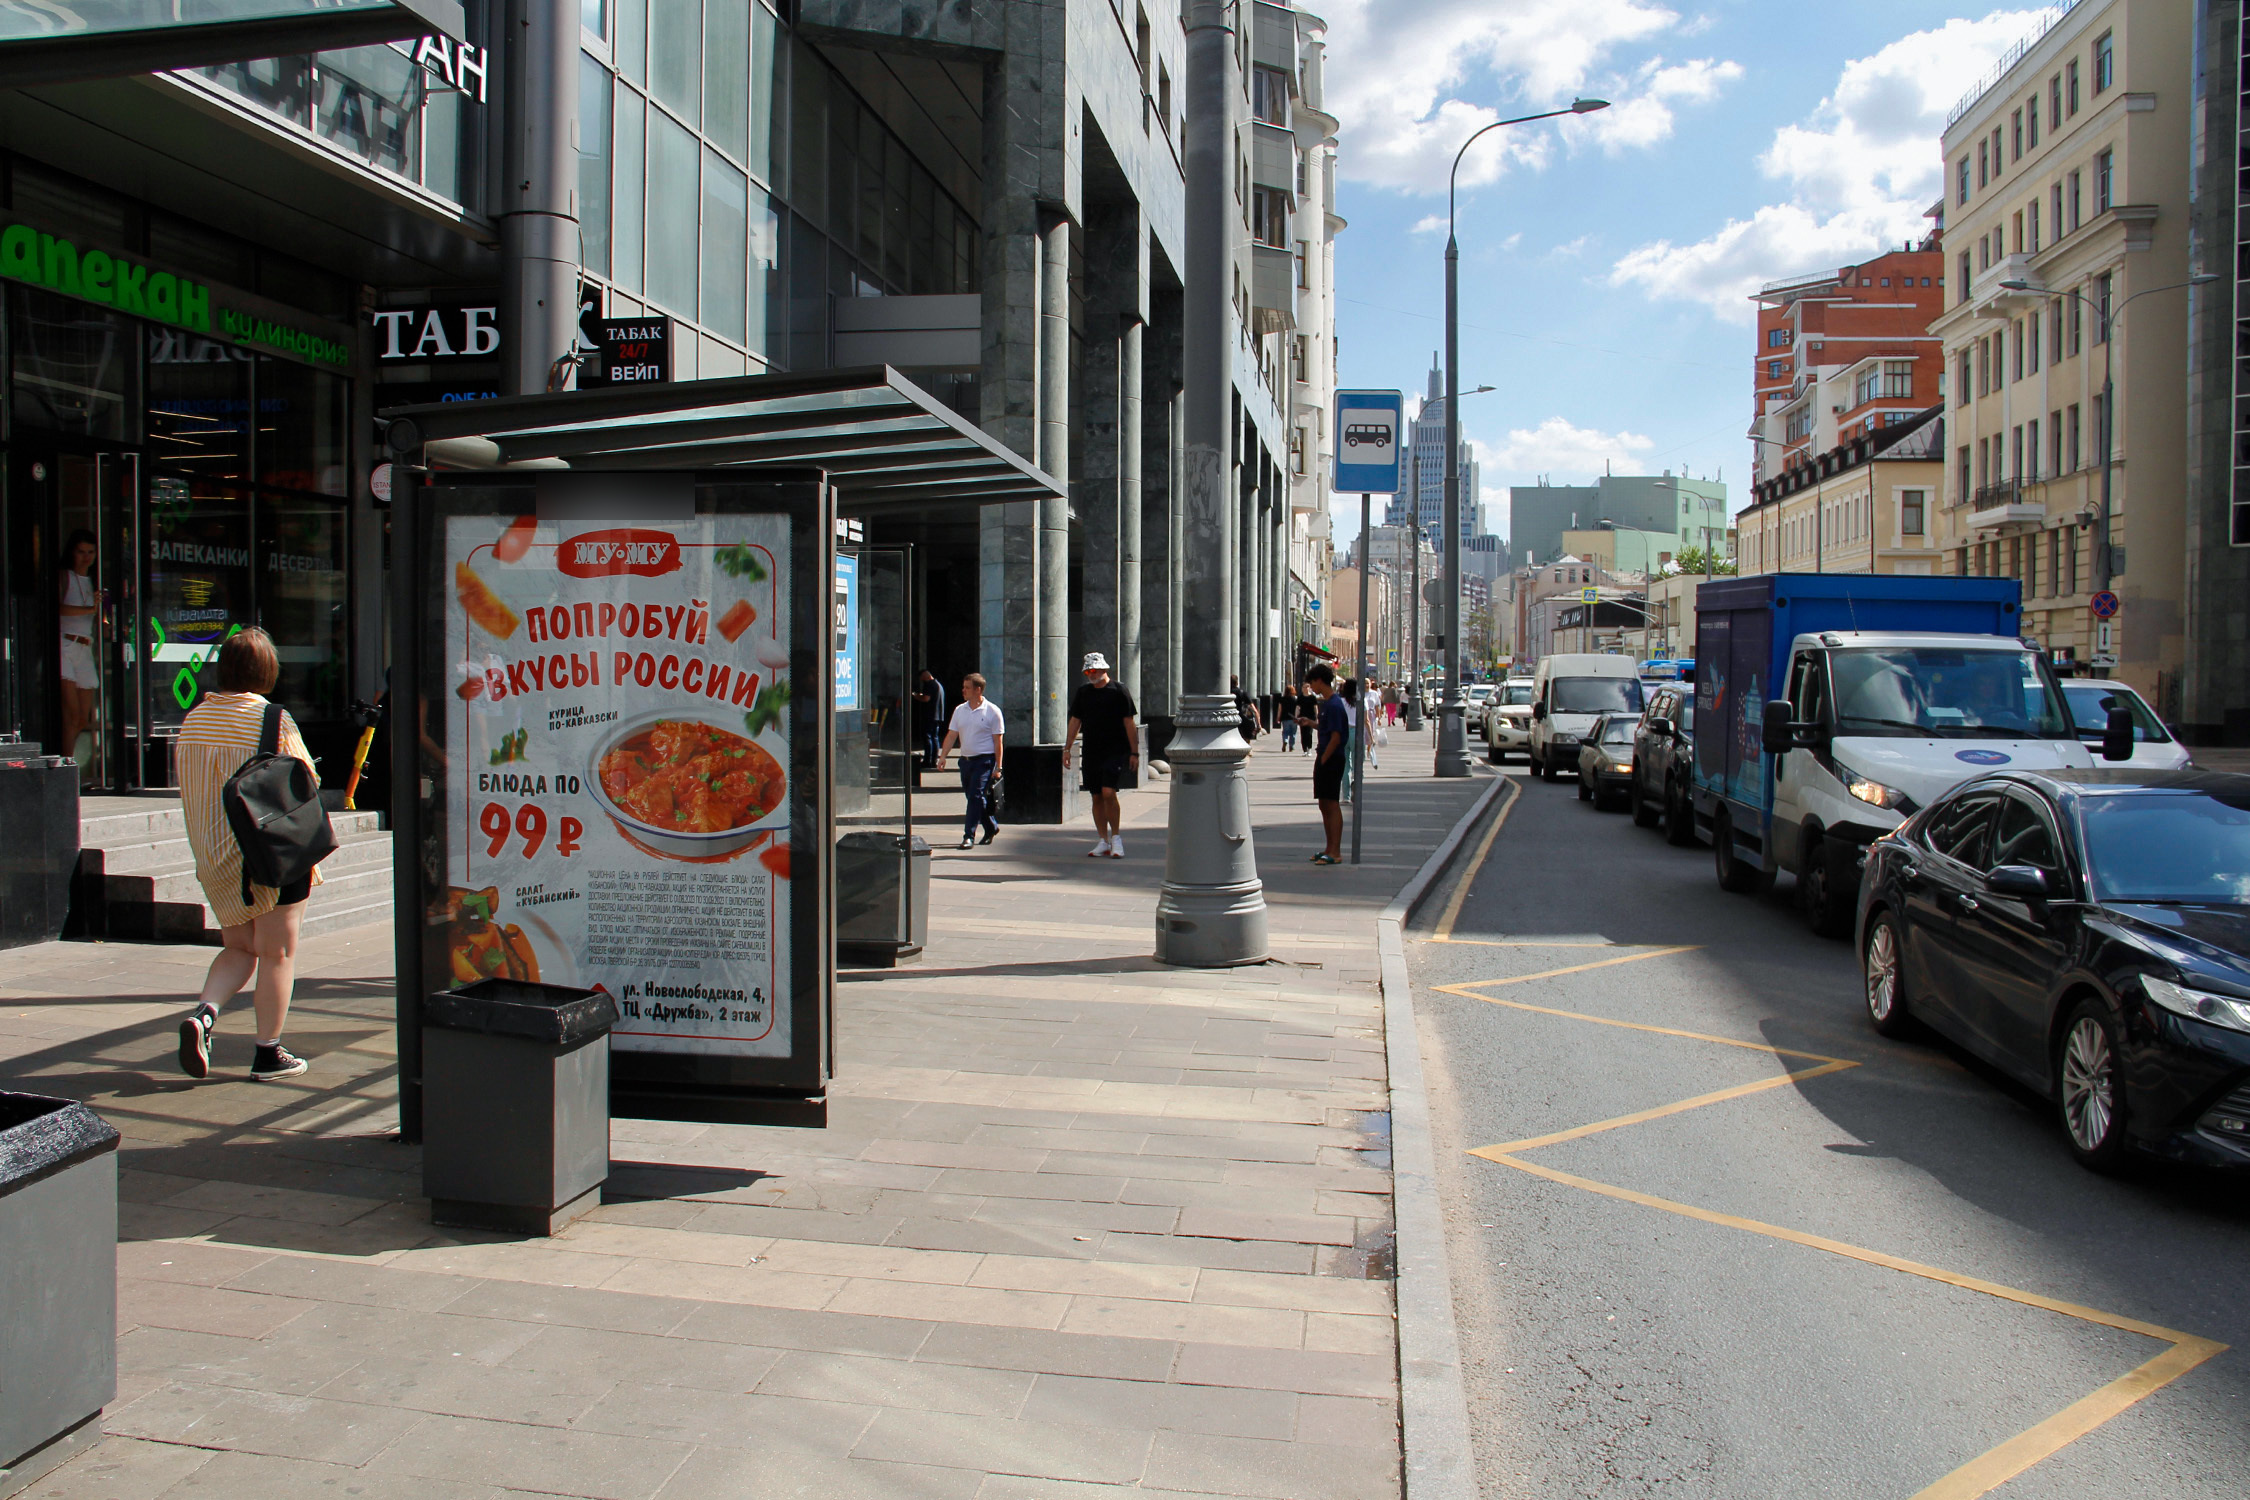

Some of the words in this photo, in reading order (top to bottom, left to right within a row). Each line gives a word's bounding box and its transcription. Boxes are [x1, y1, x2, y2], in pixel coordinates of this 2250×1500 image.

[219, 307, 348, 367] кулинария
[606, 326, 662, 341] ТАБАК
[619, 343, 649, 359] 24/7
[611, 362, 659, 381] ВЕЙП
[150, 540, 248, 568] ЗАПЕКАНКИ
[268, 552, 334, 574] ДЕСЕРТЫ
[525, 598, 710, 645] ПОПРОБУЙ
[485, 651, 600, 703] ВКУСЫ
[614, 651, 760, 709] РОССИИ
[549, 706, 585, 721] КУРИЦА
[549, 710, 618, 731] ПО-КАВКАЗСКИ
[478, 773, 548, 795] БЛЮДА
[555, 774, 580, 794] ПО
[479, 802, 548, 861] 99
[515, 883, 544, 897] САЛАТ
[515, 890, 581, 908] «КУБАНСКИЙ»
[622, 983, 641, 1001] ул.
[645, 982, 748, 1005] Новослободская,
[752, 987, 766, 1005] 4,
[622, 1000, 640, 1019] ТЦ
[644, 1002, 714, 1023] «Дружба»,
[719, 1006, 728, 1022] 2
[731, 1008, 762, 1024] этаж
